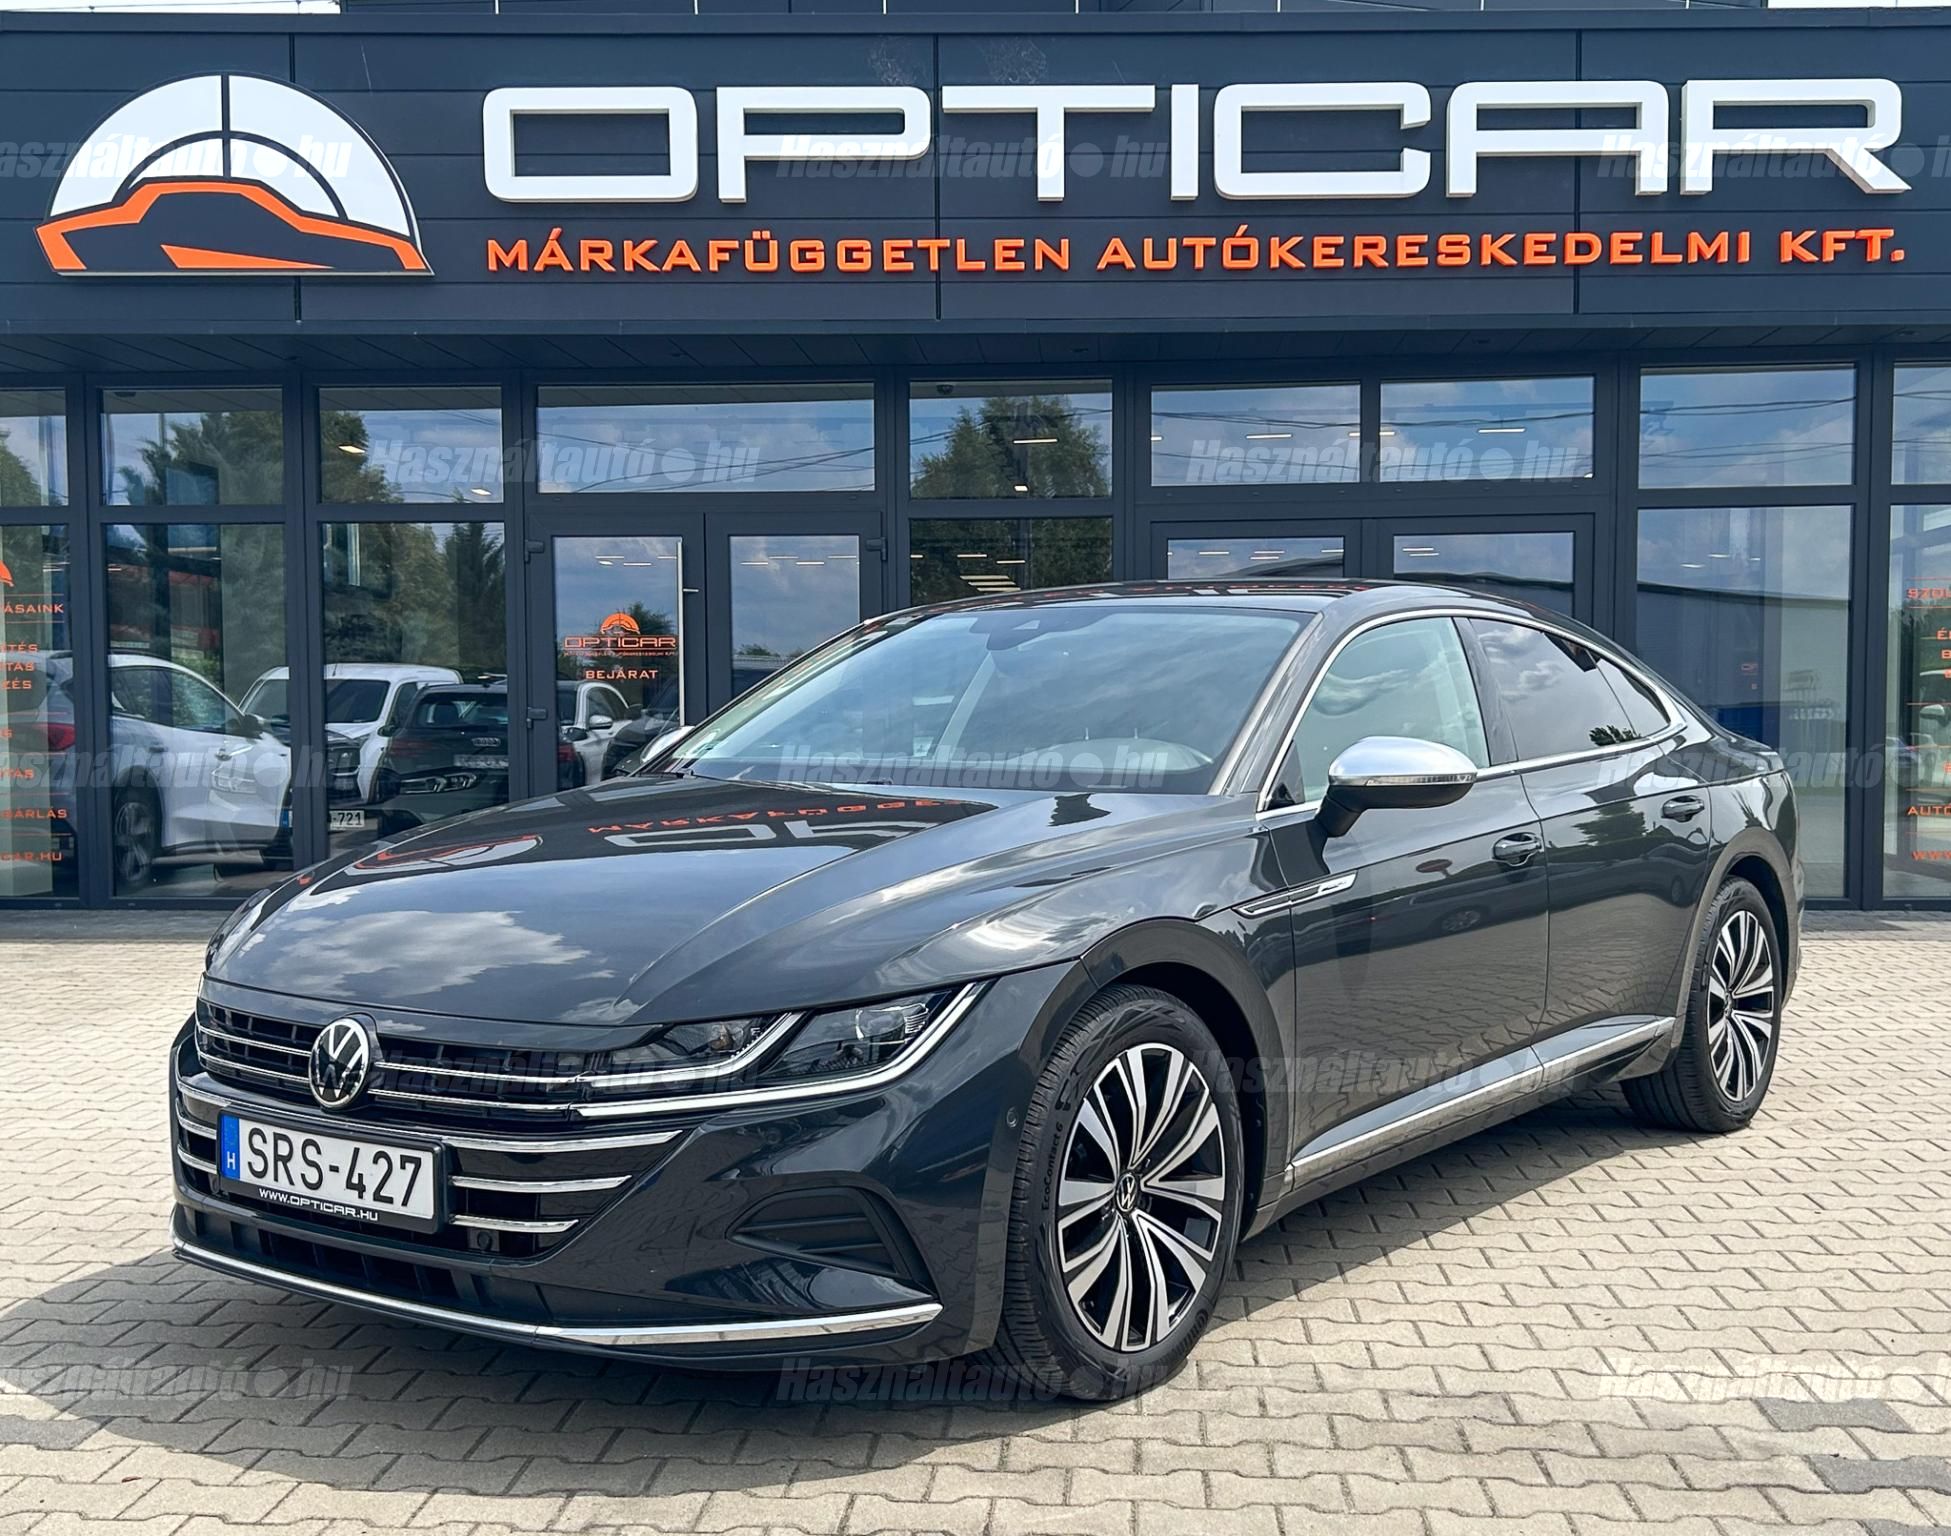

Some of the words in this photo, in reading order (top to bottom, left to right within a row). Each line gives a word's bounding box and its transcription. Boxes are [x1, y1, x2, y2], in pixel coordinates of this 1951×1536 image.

[483, 78, 1912, 203] OPTICAR
[487, 226, 1070, 273] MÁRKAFÜGGETLEN
[1096, 223, 1752, 272] AUTÓKERESKEDELMI
[1779, 228, 1906, 264] KFT.
[564, 637, 677, 648] OPTICAR
[585, 666, 659, 679] BEJÁRAT
[226, 1150, 236, 1171] H
[247, 1127, 422, 1207] SRS-427
[258, 1187, 379, 1222] WWW.OPTICAR.HU
